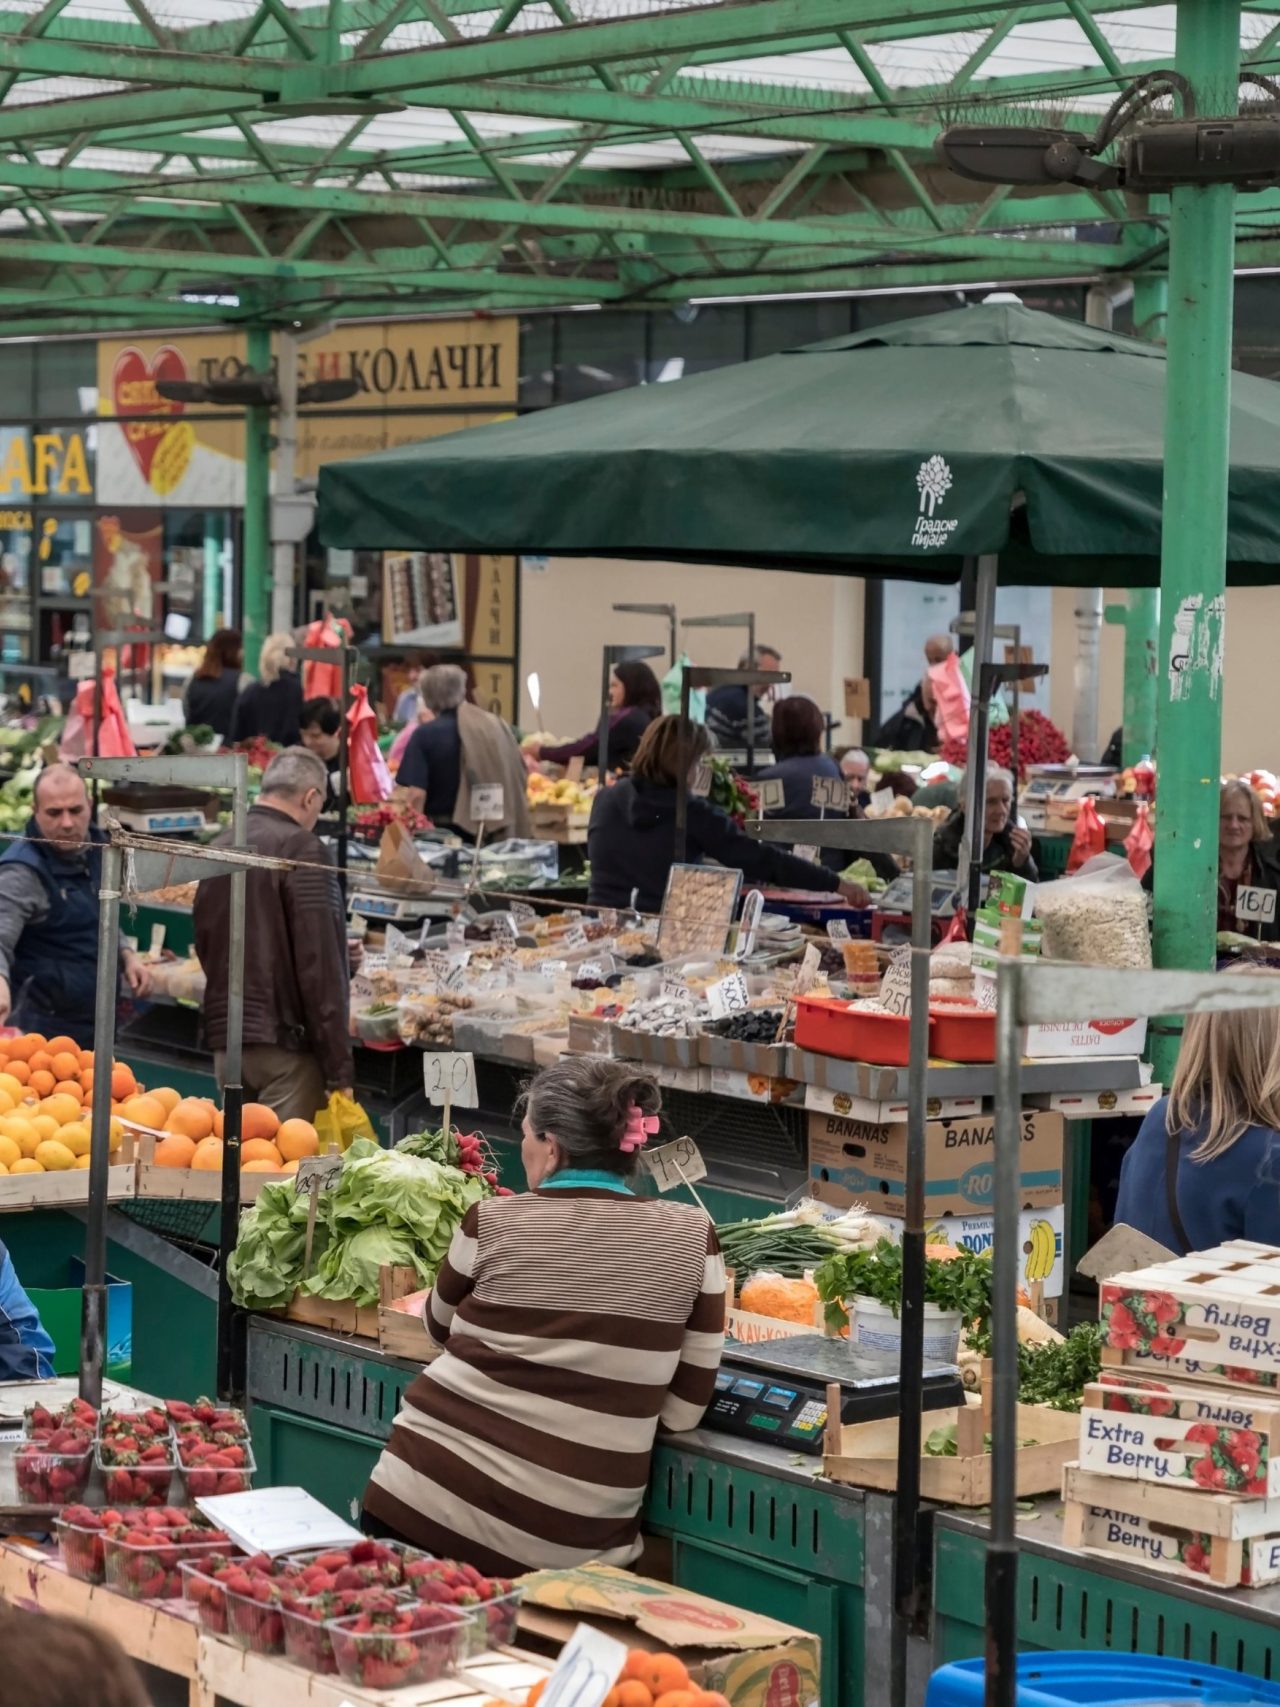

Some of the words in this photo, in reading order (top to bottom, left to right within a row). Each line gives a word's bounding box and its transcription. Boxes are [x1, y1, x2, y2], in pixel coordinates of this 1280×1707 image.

[349, 343, 502, 393] КОЛАЧИ
[915, 516, 958, 534] Градске
[911, 532, 948, 550] пијаце
[1238, 889, 1275, 914] 160
[430, 1056, 470, 1093] 20
[825, 1117, 890, 1146] BANANAS
[944, 1122, 1036, 1149] BANAS
[962, 1220, 994, 1232] PREMIU
[1202, 1303, 1271, 1338] Berry
[1087, 1417, 1145, 1446] Extra
[1106, 1444, 1171, 1478] Berry
[1106, 1523, 1164, 1559] Berry
